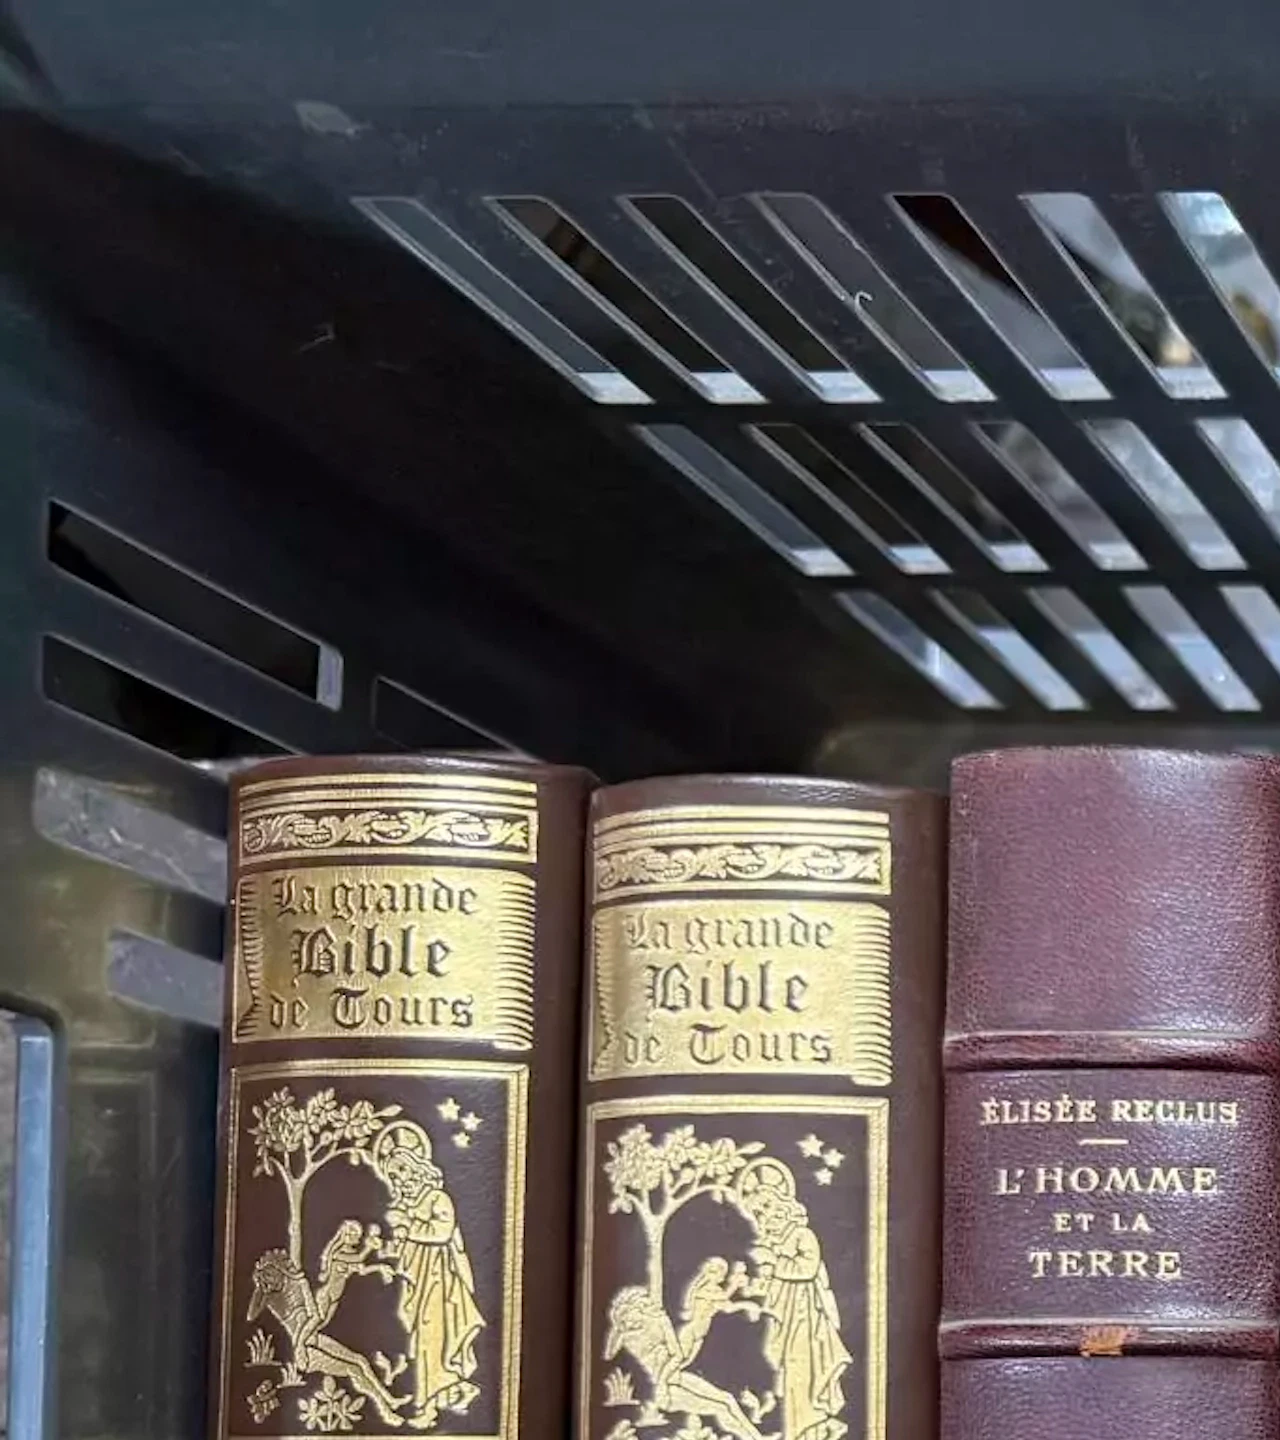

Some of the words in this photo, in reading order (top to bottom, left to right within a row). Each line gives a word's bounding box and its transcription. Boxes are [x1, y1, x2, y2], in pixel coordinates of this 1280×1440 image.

[270, 876, 317, 917] La
[328, 877, 479, 920] grande
[292, 924, 454, 978] Bible
[625, 912, 671, 949] La
[681, 912, 834, 952] grande
[648, 961, 809, 1013] Bible
[268, 994, 310, 1029] de
[329, 987, 473, 1029] Tours
[625, 1029, 661, 1064] de
[687, 1023, 832, 1064] Tours
[1111, 1100, 1239, 1126] RECLUS
[998, 1165, 1219, 1196] L'HOMME
[1055, 1213, 1093, 1234] ET
[1113, 1212, 1152, 1233] LA
[1029, 1250, 1181, 1280] TERRE
